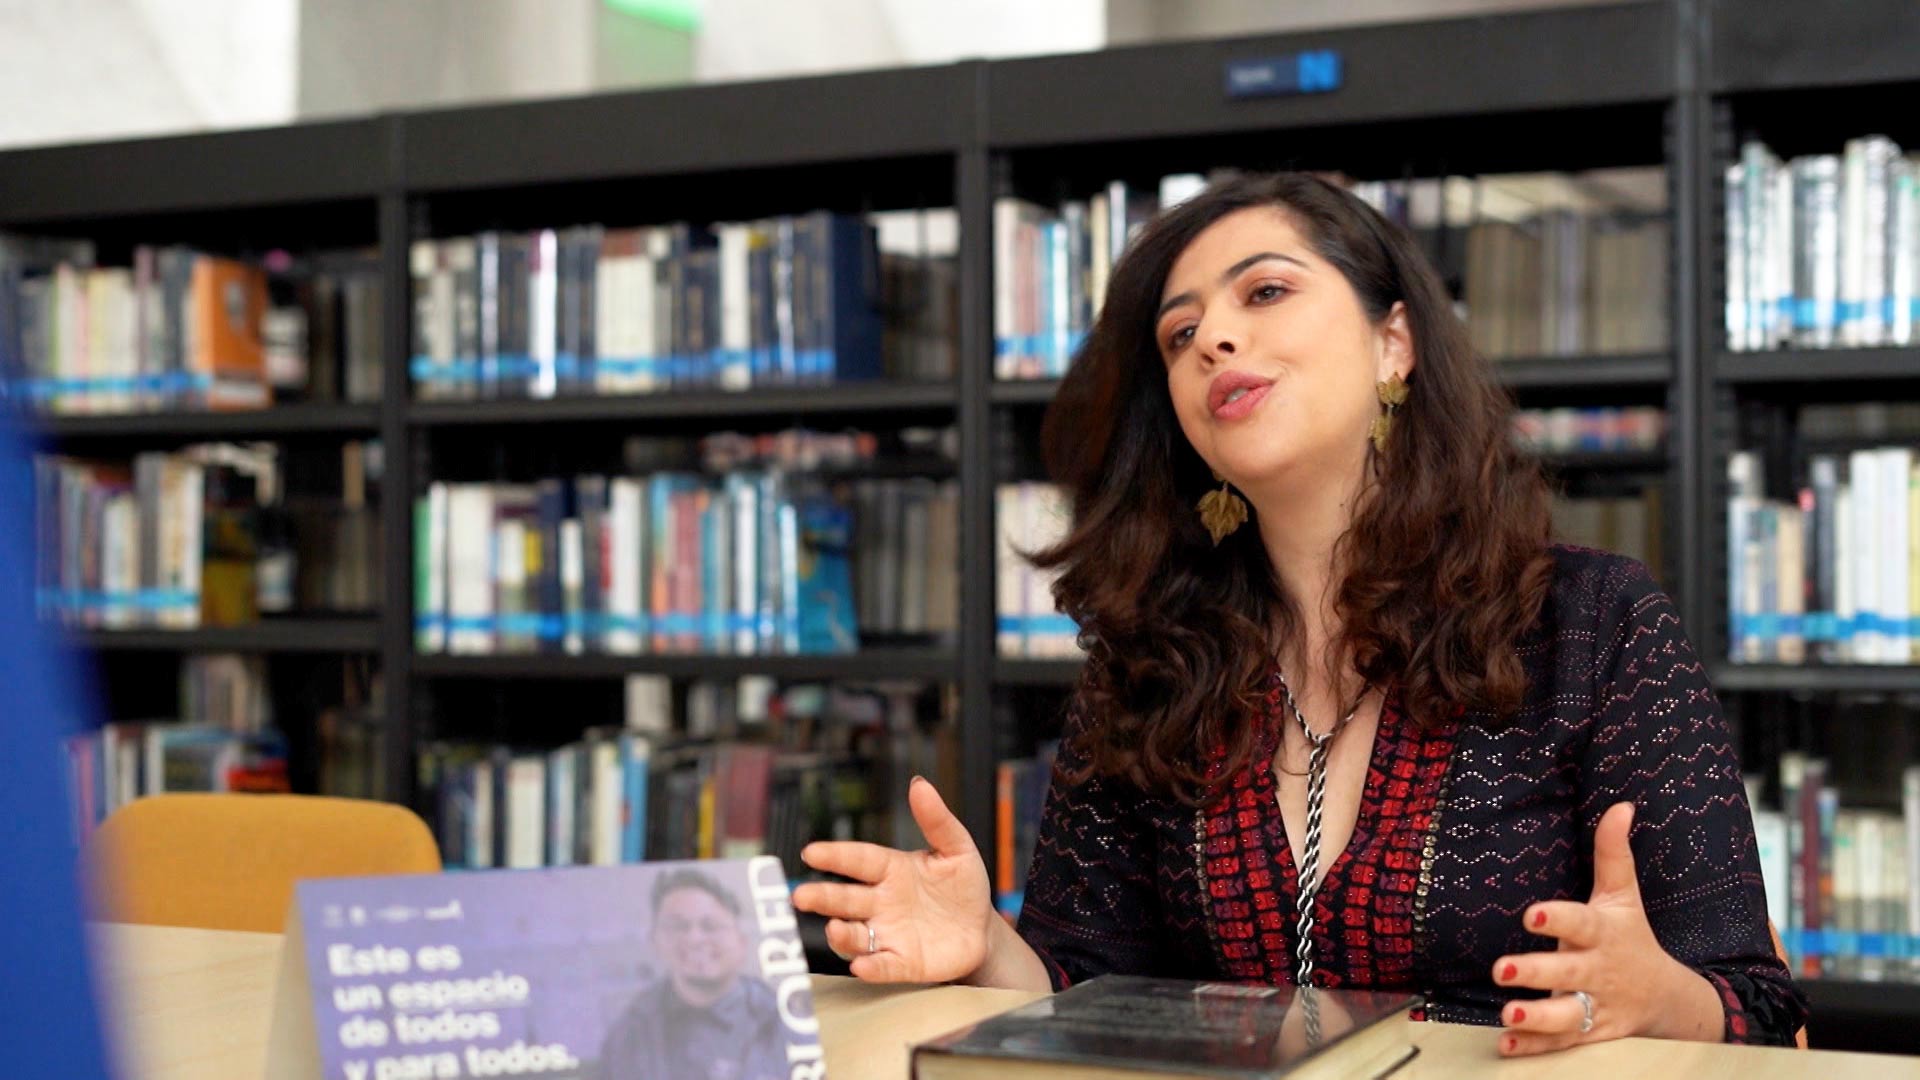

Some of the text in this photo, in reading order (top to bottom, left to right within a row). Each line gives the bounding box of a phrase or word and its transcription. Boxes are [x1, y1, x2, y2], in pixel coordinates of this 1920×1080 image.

[328, 944, 461, 976] Este es
[334, 970, 530, 1012] un espacio
[339, 1008, 500, 1048] de todos
[374, 1052, 460, 1080] para
[464, 1040, 579, 1077] todos.
